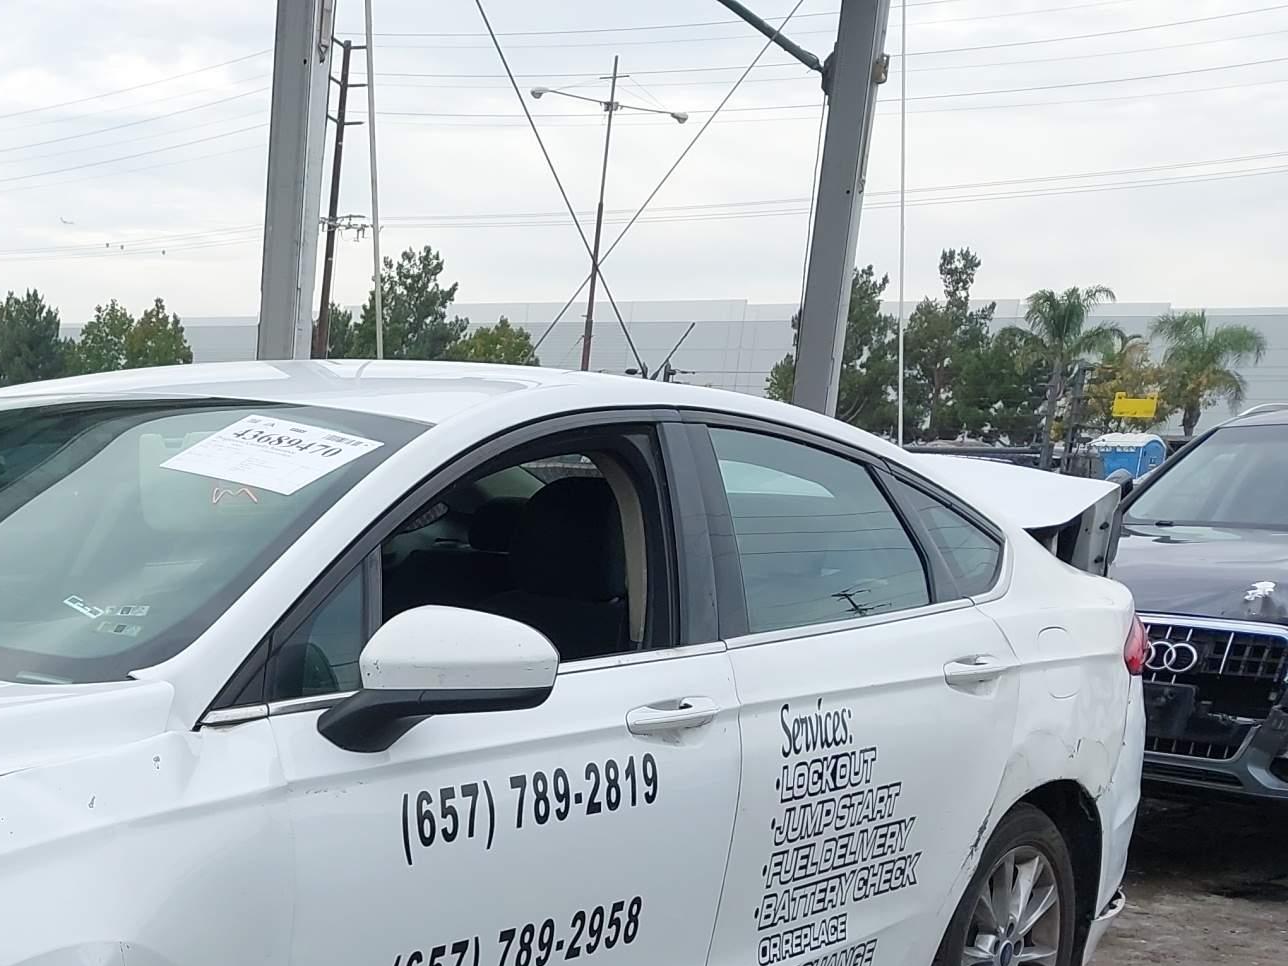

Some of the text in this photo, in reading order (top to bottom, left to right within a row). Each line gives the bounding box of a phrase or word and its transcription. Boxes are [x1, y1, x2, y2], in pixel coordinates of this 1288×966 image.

[233, 427, 344, 458] 43689470
[780, 698, 853, 758] Services:
[780, 746, 877, 803] LOCKOUT
[402, 753, 658, 866] (657) 789-2819
[818, 816, 917, 874] DELIVERY
[758, 852, 923, 931] BATTERY CHECK
[758, 913, 848, 966] OR REPLACE
